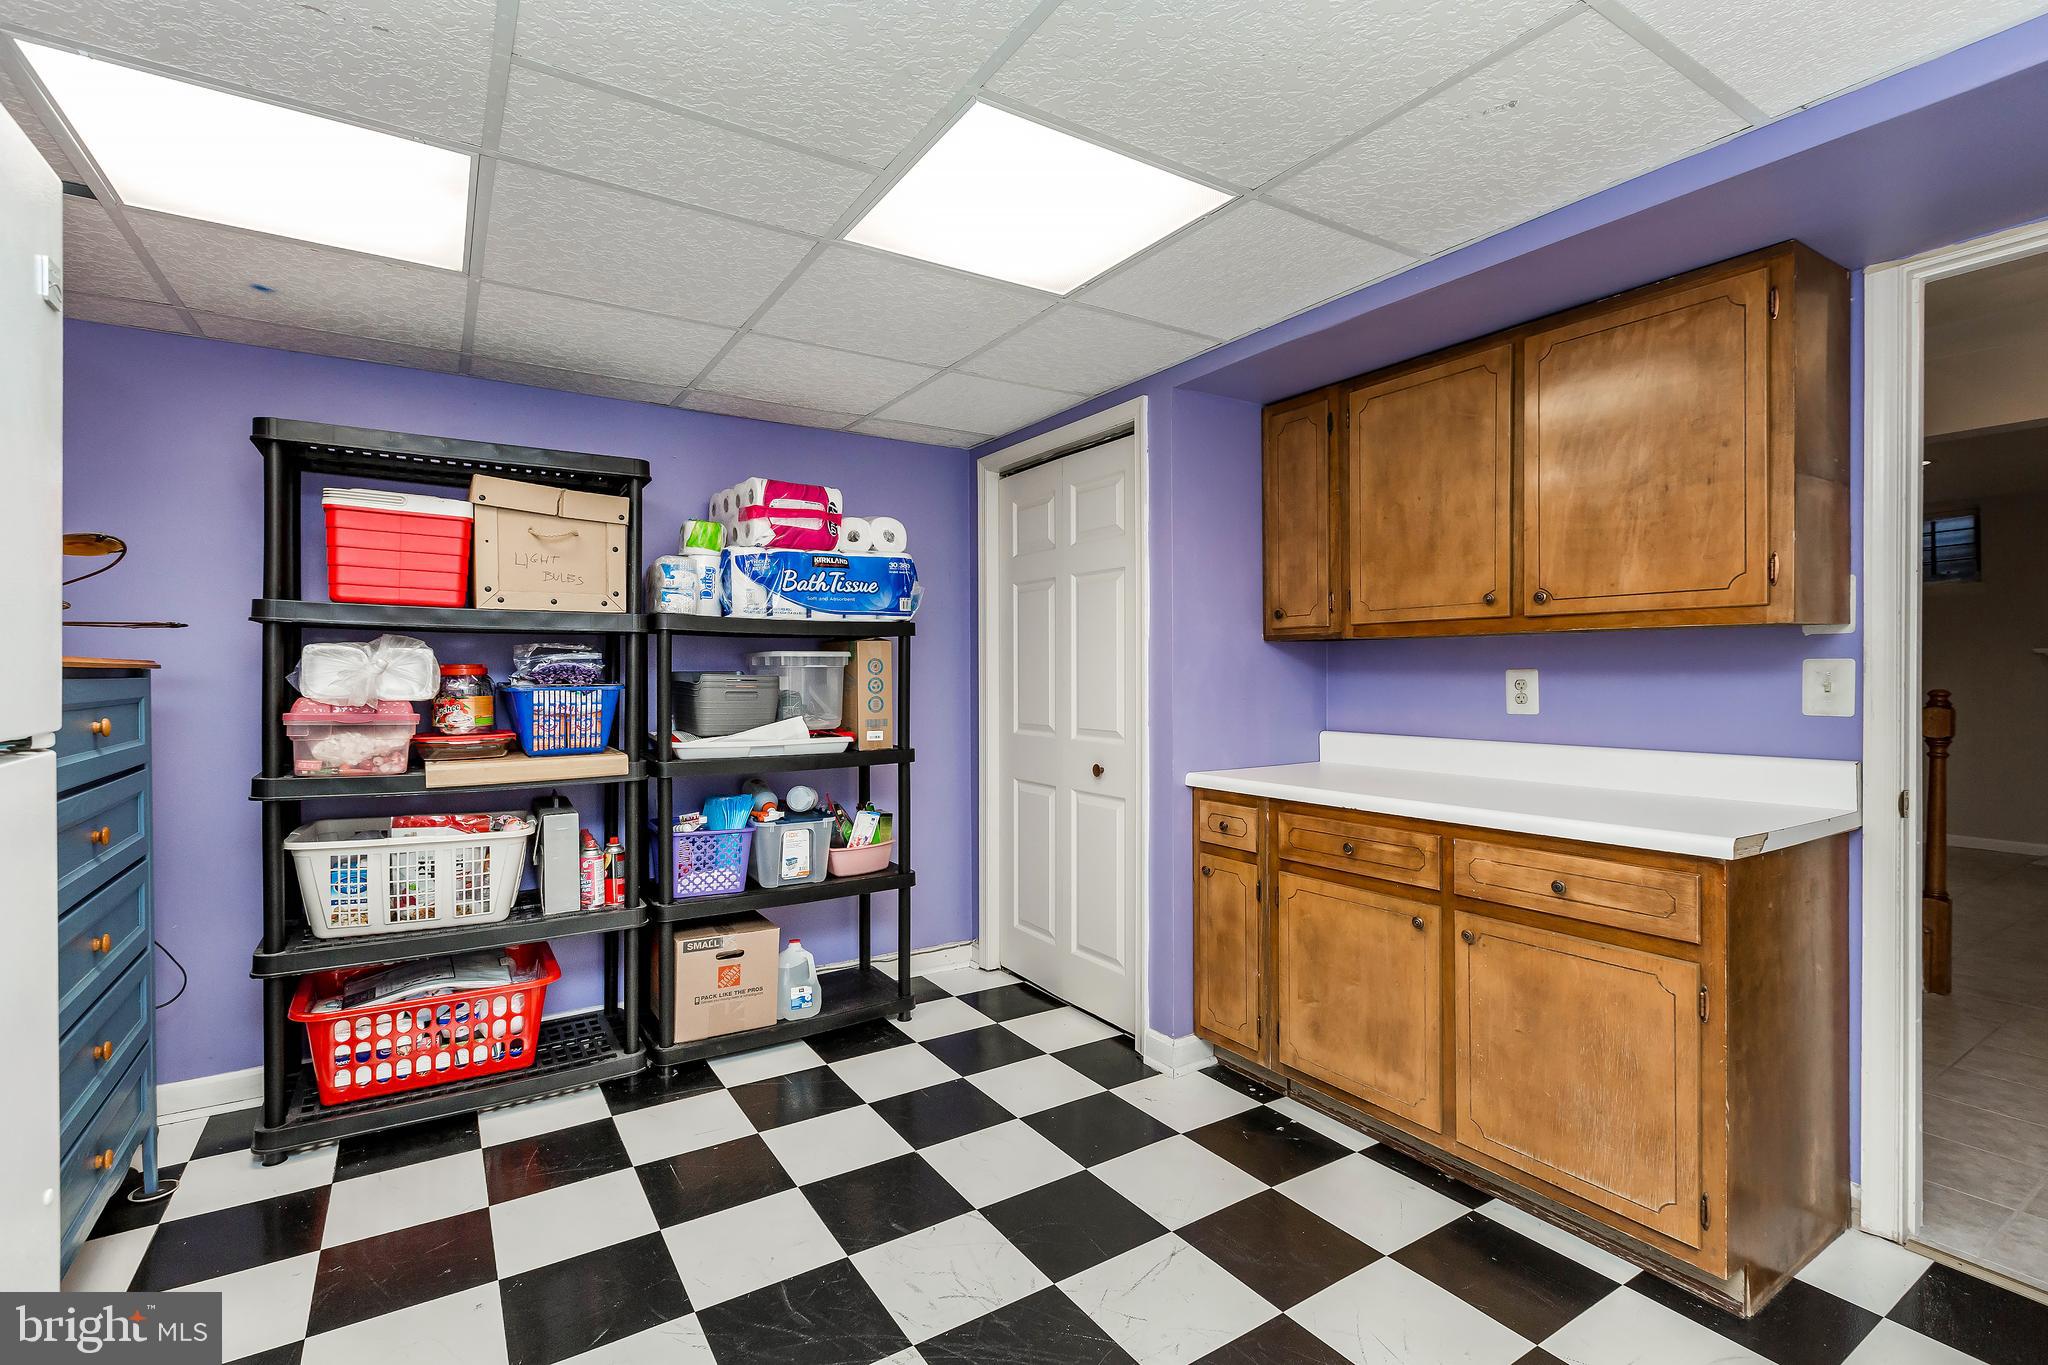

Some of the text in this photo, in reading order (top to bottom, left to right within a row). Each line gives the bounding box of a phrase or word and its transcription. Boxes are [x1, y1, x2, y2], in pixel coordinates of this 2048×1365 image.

[514, 551, 561, 569] LIGHT
[813, 556, 848, 565] KIRKLAND
[781, 569, 878, 593] Bath Tissue
[687, 939, 719, 951] SMALL
[700, 993, 718, 1001] PACK
[718, 990, 733, 998] LIKE
[734, 988, 746, 996] THE
[747, 986, 764, 994] PROS
